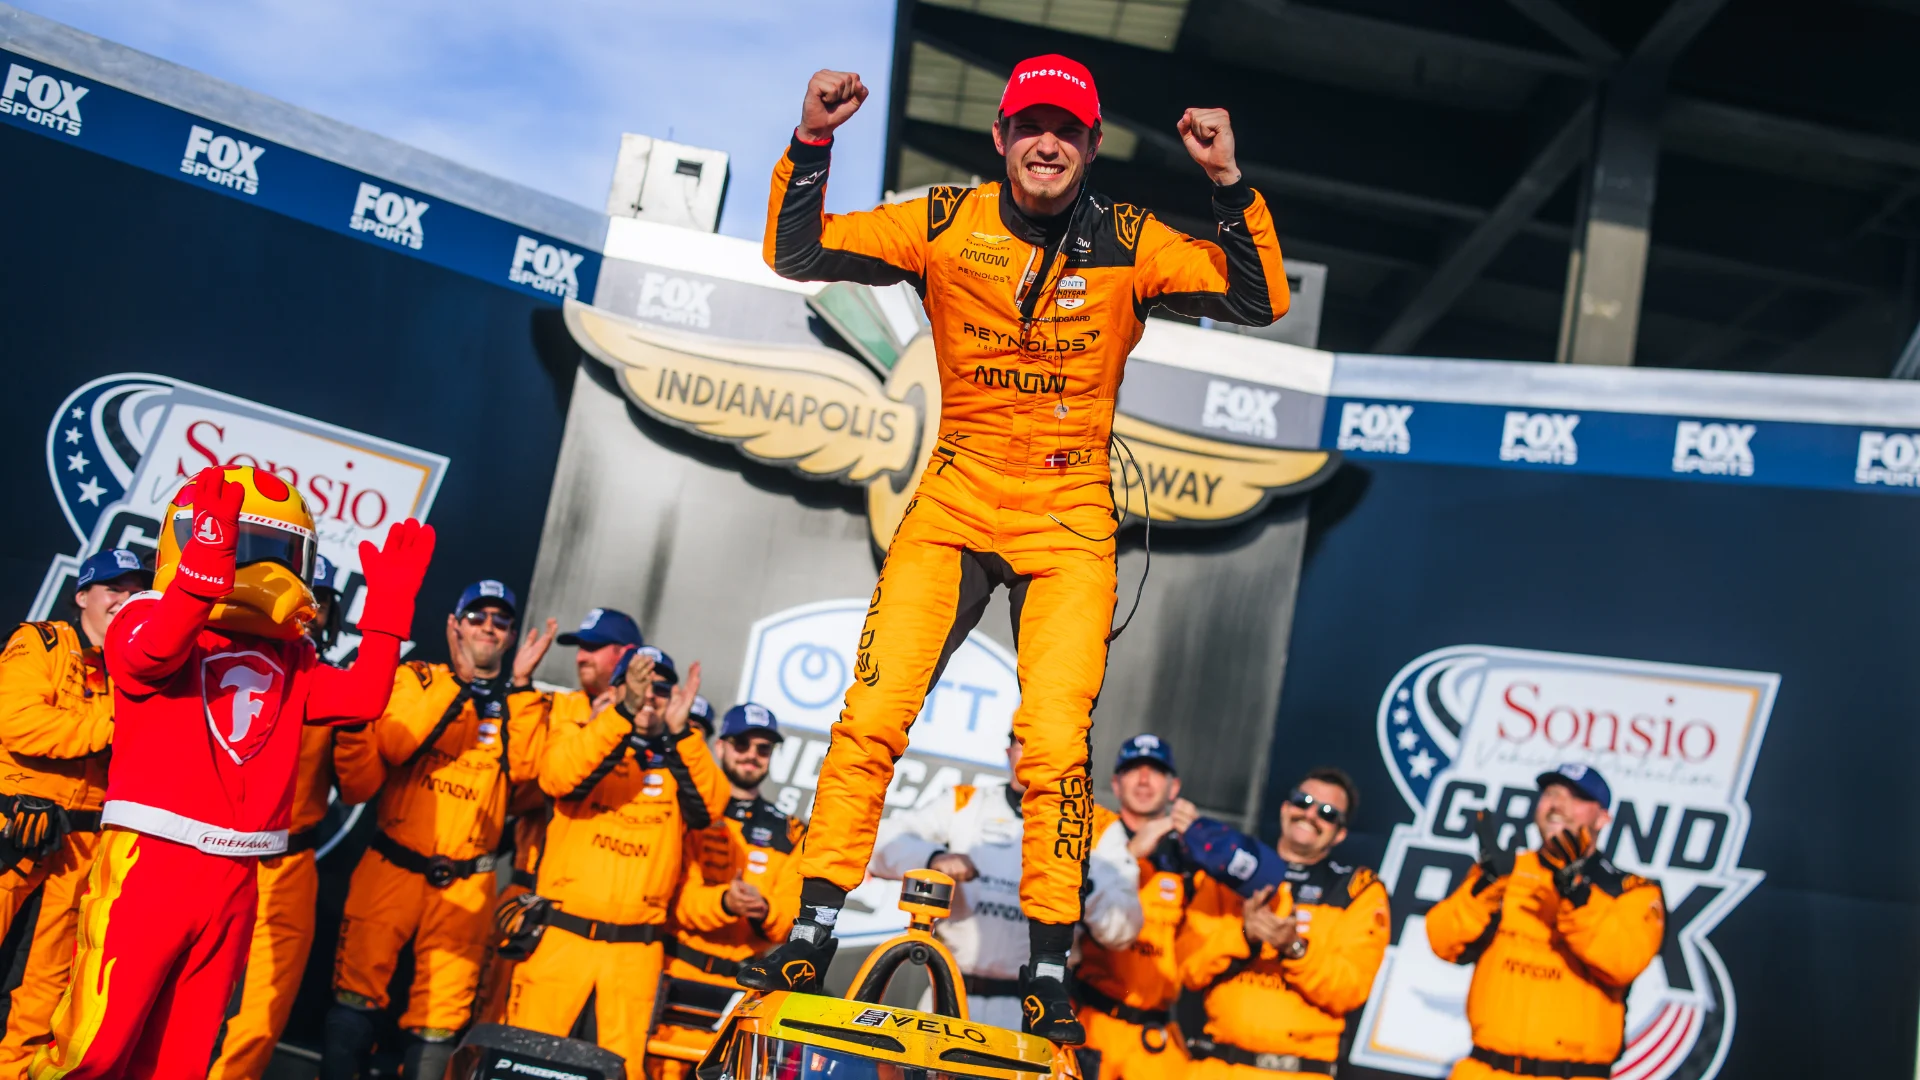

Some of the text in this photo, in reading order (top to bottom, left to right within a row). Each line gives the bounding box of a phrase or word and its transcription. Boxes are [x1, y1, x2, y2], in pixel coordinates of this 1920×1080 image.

[2, 63, 90, 122] FOX
[1018, 68, 1087, 89] Firestone
[0, 98, 82, 136] SPORTS
[184, 125, 265, 182] FOX
[180, 158, 258, 195] SPORTS
[352, 182, 429, 236] FOX
[349, 216, 423, 250] SPORTS
[512, 235, 584, 286] FOX
[957, 266, 1006, 283] REYNOLDS
[508, 267, 578, 300] SPORTS
[639, 272, 716, 312] FOX
[1067, 280, 1084, 288] NTT
[636, 305, 710, 329] SPORTS
[963, 321, 1087, 352] REYNOLDS
[973, 365, 1068, 394] ARROW
[656, 368, 899, 443] INDIANAPOLIS
[1205, 380, 1281, 427] FOX
[1340, 402, 1414, 440] FOX
[1202, 412, 1278, 440] SPORTS
[1337, 434, 1411, 454] SPORTS
[1502, 411, 1580, 451] FOX
[1675, 420, 1757, 462] FOX
[1500, 444, 1578, 465] SPORTS
[1672, 456, 1755, 477] SPORTS
[176, 420, 389, 529] Snsio
[1855, 467, 1920, 488] SPOR
[178, 563, 225, 585] Fireston
[922, 680, 999, 732] TT
[1497, 680, 1716, 765] Sonsio
[1053, 777, 1086, 861] 2026
[1431, 779, 1729, 871] GRND
[202, 836, 272, 849] FIREHAWK
[891, 1013, 987, 1044] VELO
